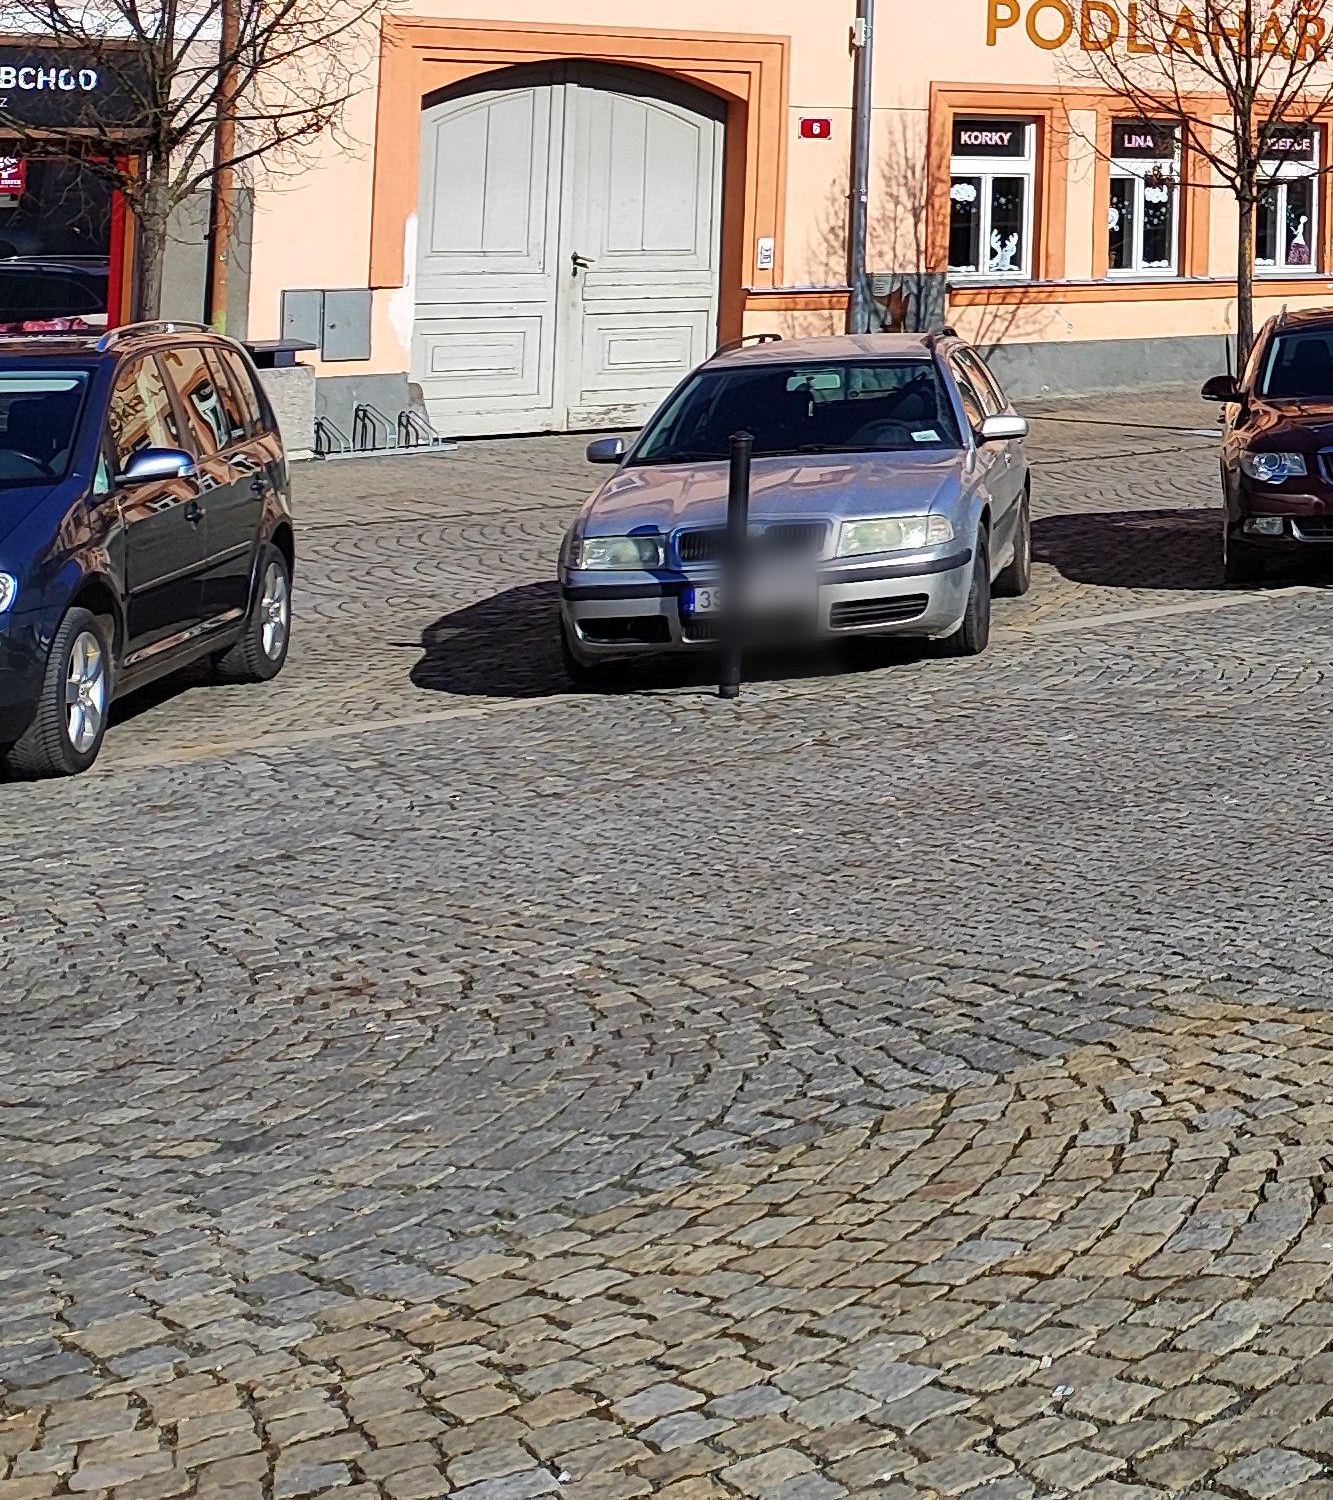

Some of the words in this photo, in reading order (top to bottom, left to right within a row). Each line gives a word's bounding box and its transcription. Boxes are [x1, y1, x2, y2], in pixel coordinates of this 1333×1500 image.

[812, 122, 821, 135] 6
[960, 131, 1013, 146] KORKY
[1123, 133, 1155, 148] LINA
